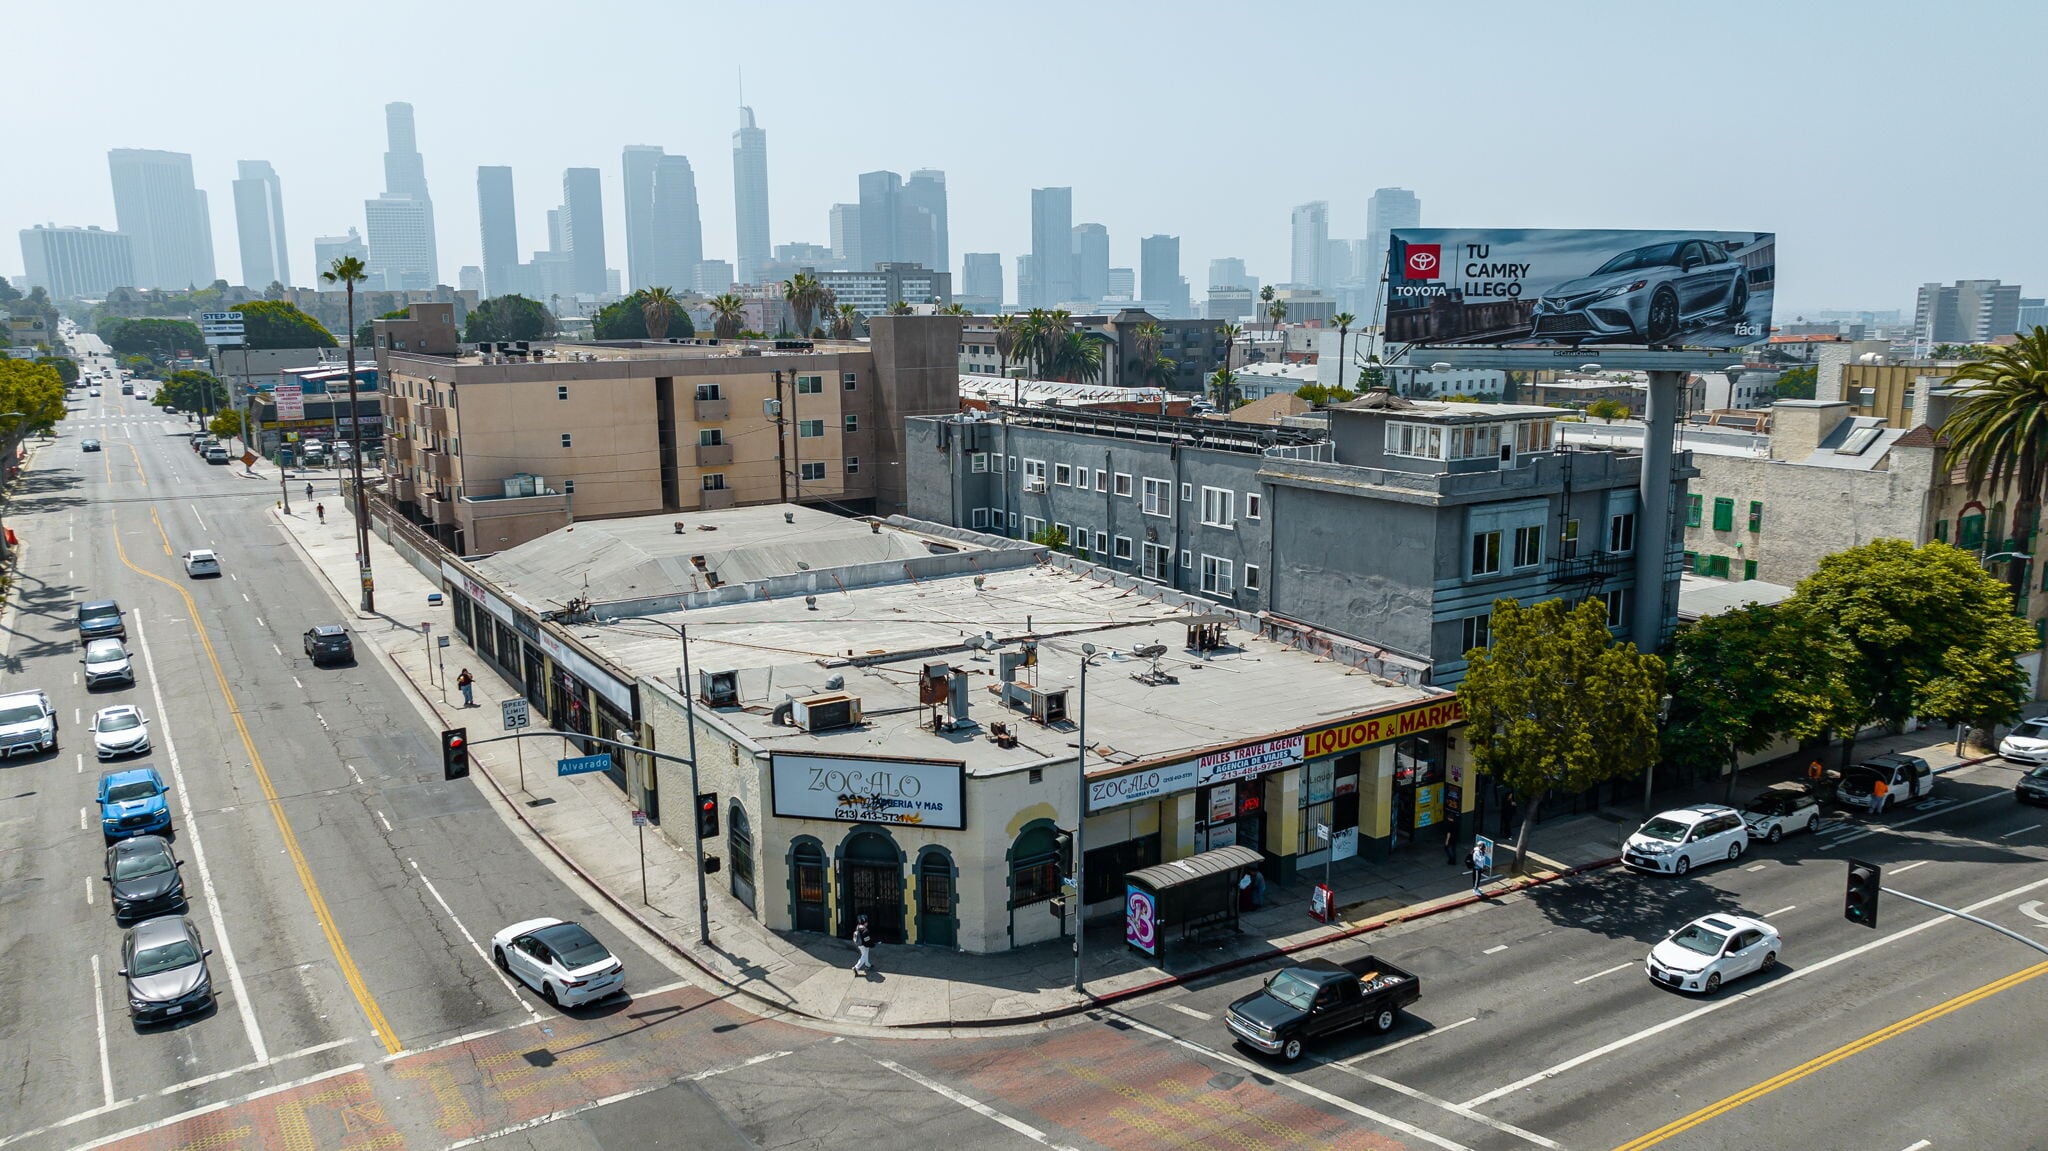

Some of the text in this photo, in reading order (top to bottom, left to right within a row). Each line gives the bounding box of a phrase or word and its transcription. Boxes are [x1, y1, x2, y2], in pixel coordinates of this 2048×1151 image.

[1466, 244, 1490, 259] TU
[1465, 263, 1531, 279] CAMRY
[1396, 286, 1447, 296] TOYOTA
[1464, 278, 1523, 297] LLEGÓ
[1733, 321, 1763, 336] fácil
[503, 700, 527, 709] SPEED
[506, 707, 525, 715] LIMIT
[507, 714, 527, 728] 35
[1304, 701, 1467, 757] LIQUOR & MARKE
[1200, 736, 1303, 768] AVILES TRAVEL AGENCY
[561, 759, 608, 773] Alvarado
[1216, 750, 1289, 773] AGENCIA DE VIAJES
[1221, 760, 1283, 780] 213-484-9725
[808, 766, 922, 798] ZOCALO
[1092, 772, 1160, 801] ZOCALO
[834, 807, 858, 820] (213)
[915, 801, 922, 809] Y
[924, 801, 943, 812] MAS
